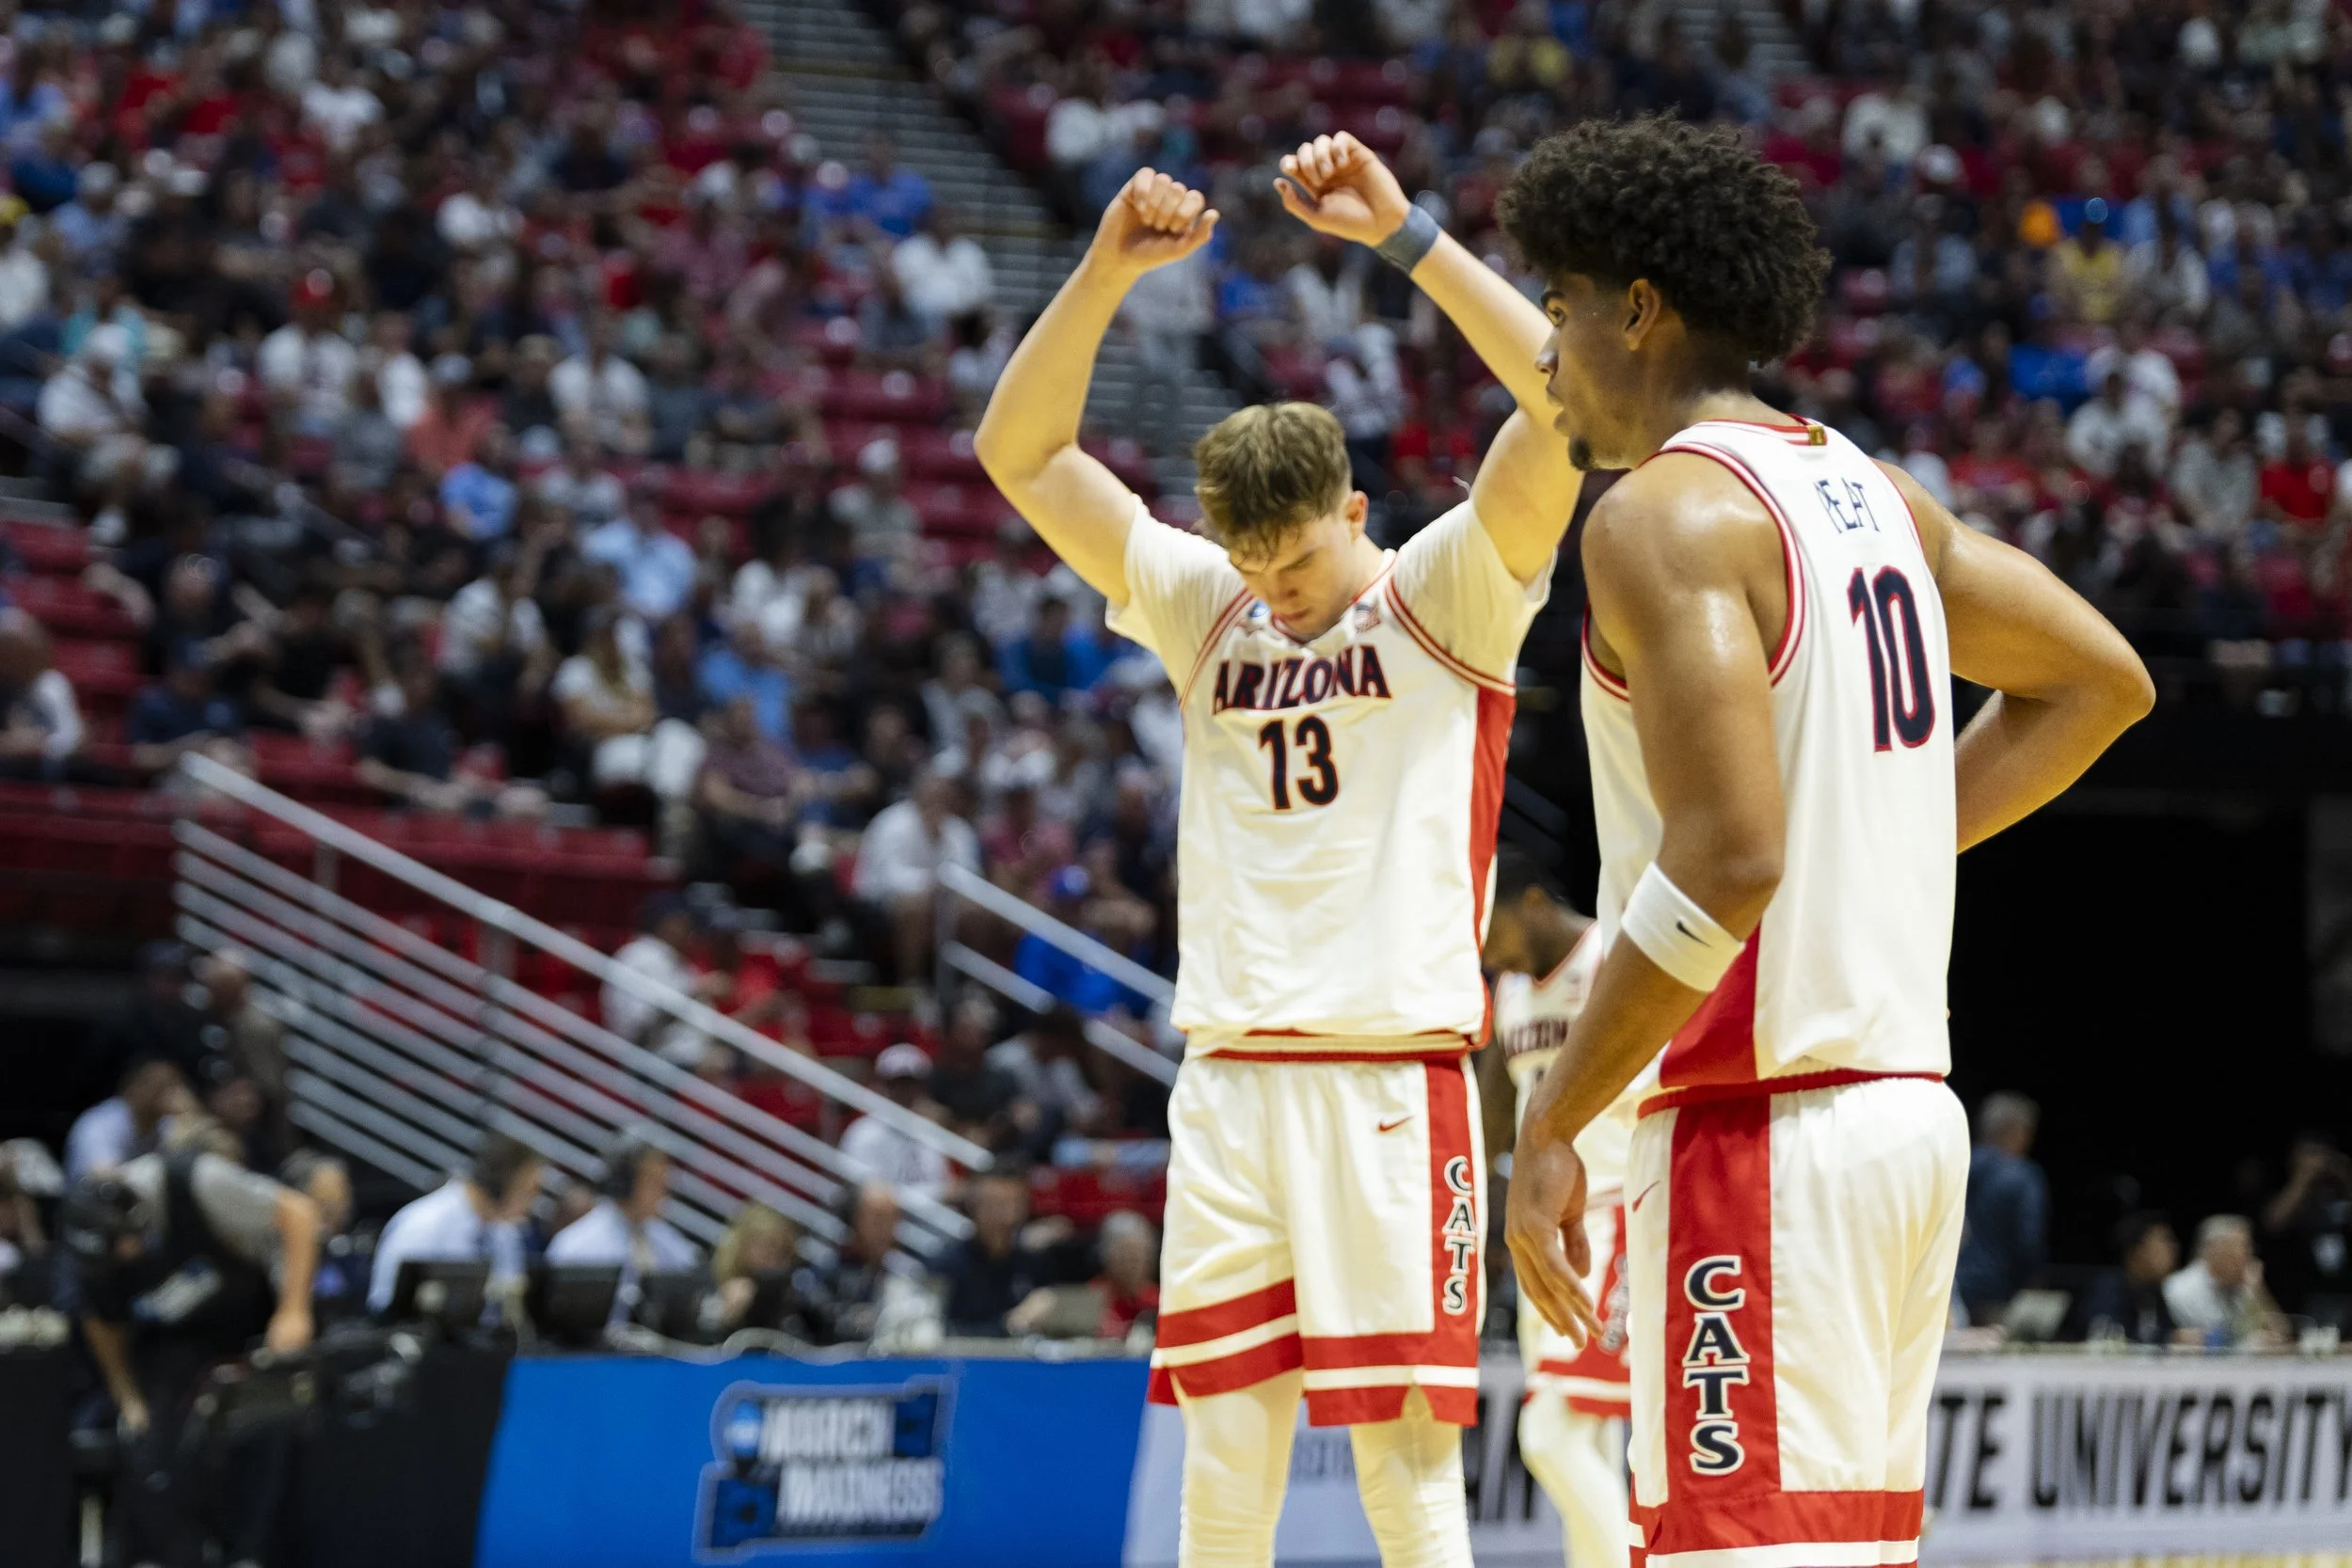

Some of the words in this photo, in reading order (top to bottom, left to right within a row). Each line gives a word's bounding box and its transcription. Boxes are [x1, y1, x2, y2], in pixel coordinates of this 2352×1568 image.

[1814, 478, 1880, 533] PEAT
[1212, 643, 1392, 716] ARIZONA
[1847, 564, 1935, 752] 10
[1259, 715, 1340, 811] 13
[1442, 1156, 1477, 1315] CATS
[1682, 1255, 1751, 1475] CATS
[758, 1396, 892, 1459] MARCH
[776, 1459, 942, 1522] MADNESS
